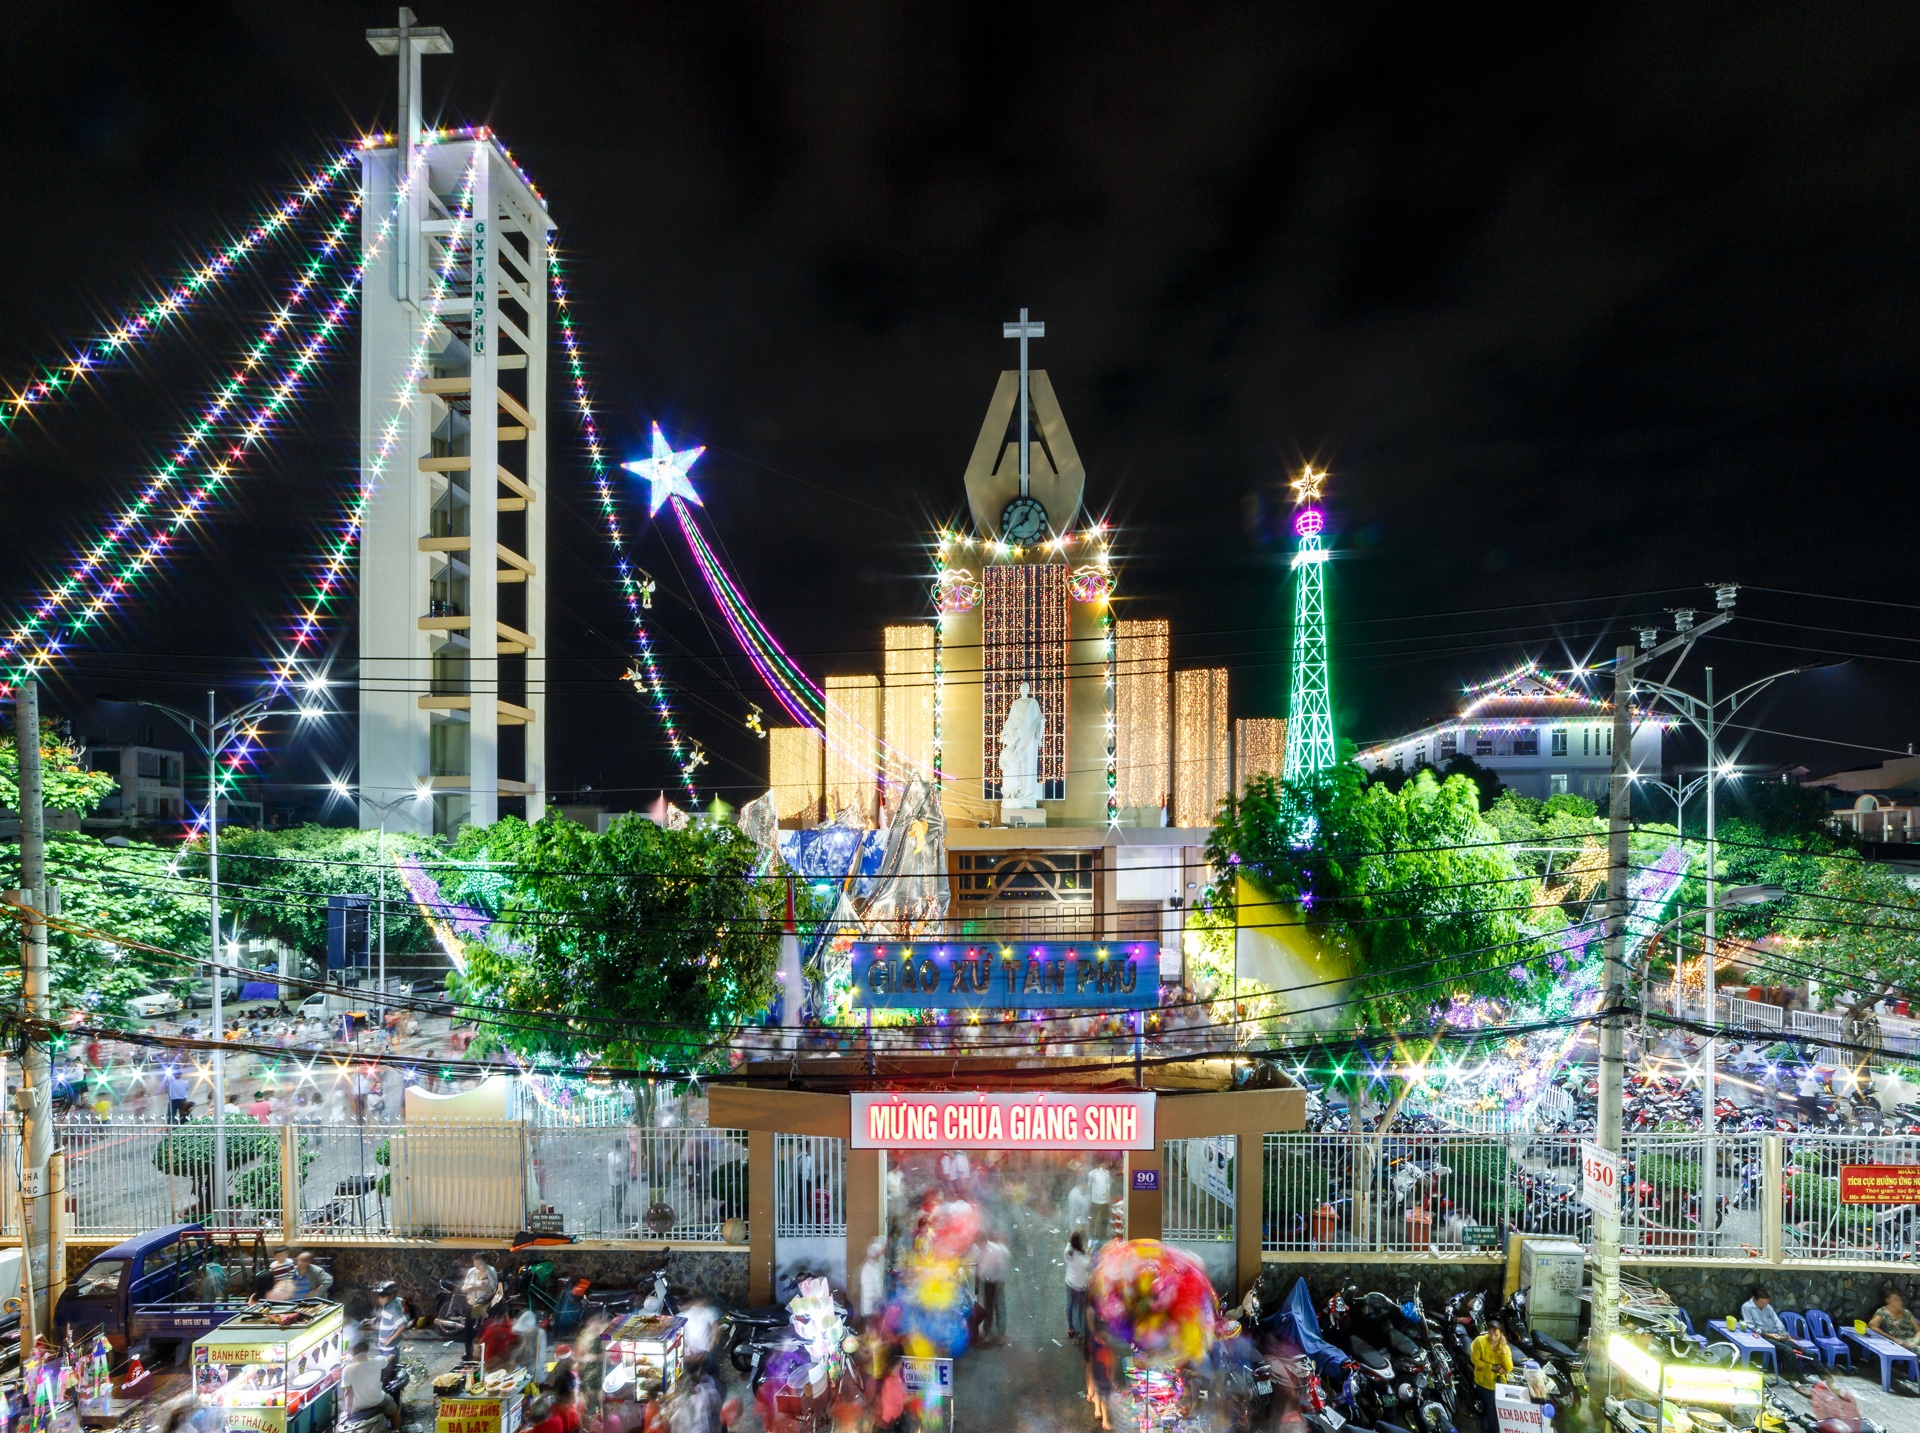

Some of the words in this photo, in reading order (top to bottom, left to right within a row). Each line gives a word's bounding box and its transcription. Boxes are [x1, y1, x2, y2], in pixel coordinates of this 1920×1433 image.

[1003, 955, 1065, 994] TÂN
[1076, 952, 1138, 994] PHÚ
[869, 1095, 938, 1141] MỪNG
[944, 1094, 1003, 1141] CHÚA
[1010, 1094, 1078, 1141] GIÁNG
[1084, 1105, 1137, 1141] SINH
[1137, 1172, 1155, 1182] 90
[1584, 1158, 1613, 1187] 450
[1847, 1176, 1861, 1186] TÍCH
[212, 1349, 233, 1360] BÁNH
[235, 1349, 249, 1360] KÉP
[242, 1415, 262, 1429] THÁI
[1498, 1407, 1514, 1420] KEM
[1529, 1410, 1544, 1427] BIỆ
